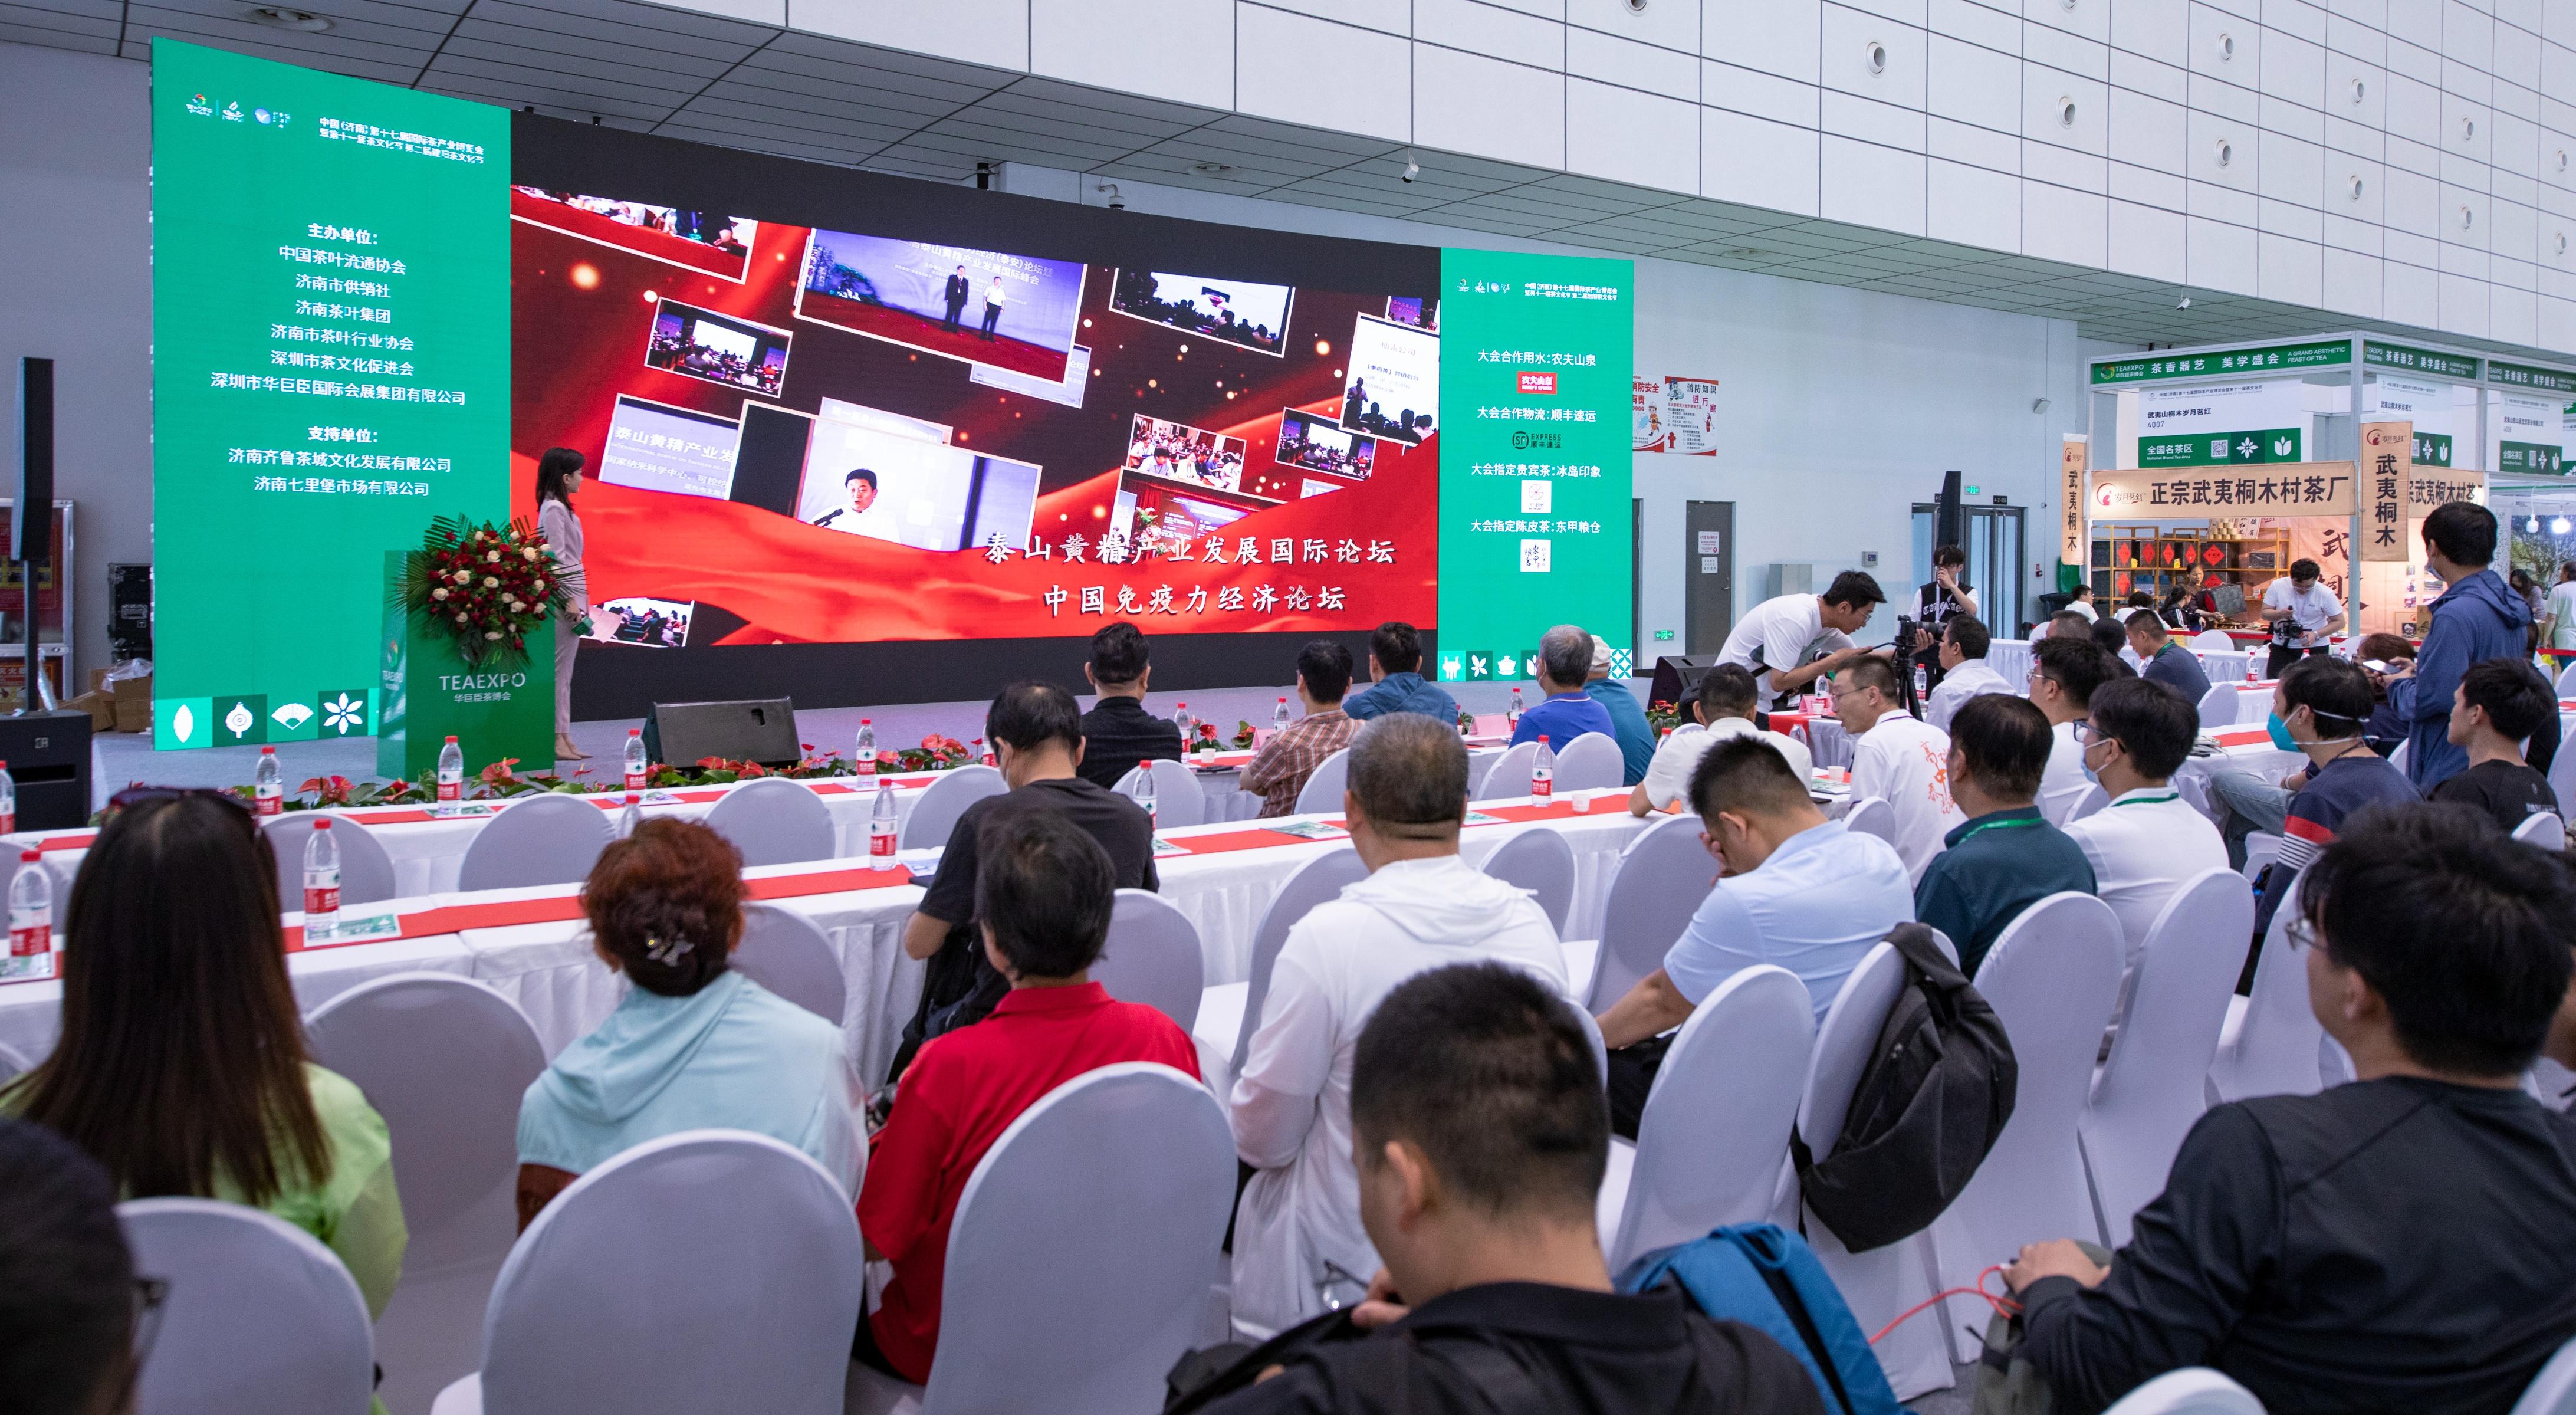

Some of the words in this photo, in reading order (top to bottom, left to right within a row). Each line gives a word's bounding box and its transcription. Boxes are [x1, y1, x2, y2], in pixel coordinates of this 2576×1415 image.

[307, 222, 378, 245] 主办单位：
[278, 245, 406, 275] 中国茶叶流通协会
[295, 273, 392, 298] 济南市供销社
[295, 300, 392, 324] 济南茶叶集团
[270, 323, 414, 351] 济南市茶叶行业协会
[270, 350, 414, 376] 深圳市茶文化促进会
[1477, 349, 1597, 367] 大会合作用水：农夫山泉
[2115, 364, 2144, 372] TEAEXPO
[2151, 359, 2205, 374] 茶香器艺
[2222, 353, 2279, 369] 美学盛会
[2386, 350, 2414, 366] 茶香器艺
[2420, 356, 2447, 372] 美学盛会
[210, 372, 466, 405] 深圳市华巨臣国际会展集团有限公司
[1687, 383, 1717, 395] 消防知识
[1477, 405, 1597, 422] 大会合作物流：顺丰速运
[2147, 408, 2212, 419] 武夷山桐木岁月茗红
[307, 425, 378, 443] 支持单位：
[1515, 435, 1526, 445] SF
[1530, 433, 1562, 441] EXPRESS
[228, 448, 451, 472] 济南齐鲁茶城文化发展有限公司
[2147, 444, 2193, 455] 全国名茶区
[1471, 462, 1602, 478] 大会指定贵宾茶：冰岛印象
[254, 476, 429, 497] 济南七里堡市场有限公司
[2150, 475, 2350, 506] 正宗武夷桐木村茶厂
[2067, 470, 2078, 552] 武夷桐木
[2375, 453, 2398, 547] 武夷桐木
[1470, 519, 1601, 534] 大会指定陈皮茶：东甲粮仓
[984, 531, 1398, 565] 泰山黄精产业发展国际论坛
[1043, 584, 1346, 616] 中国免疫力经济论坛
[438, 672, 526, 691] TEAEXPO
